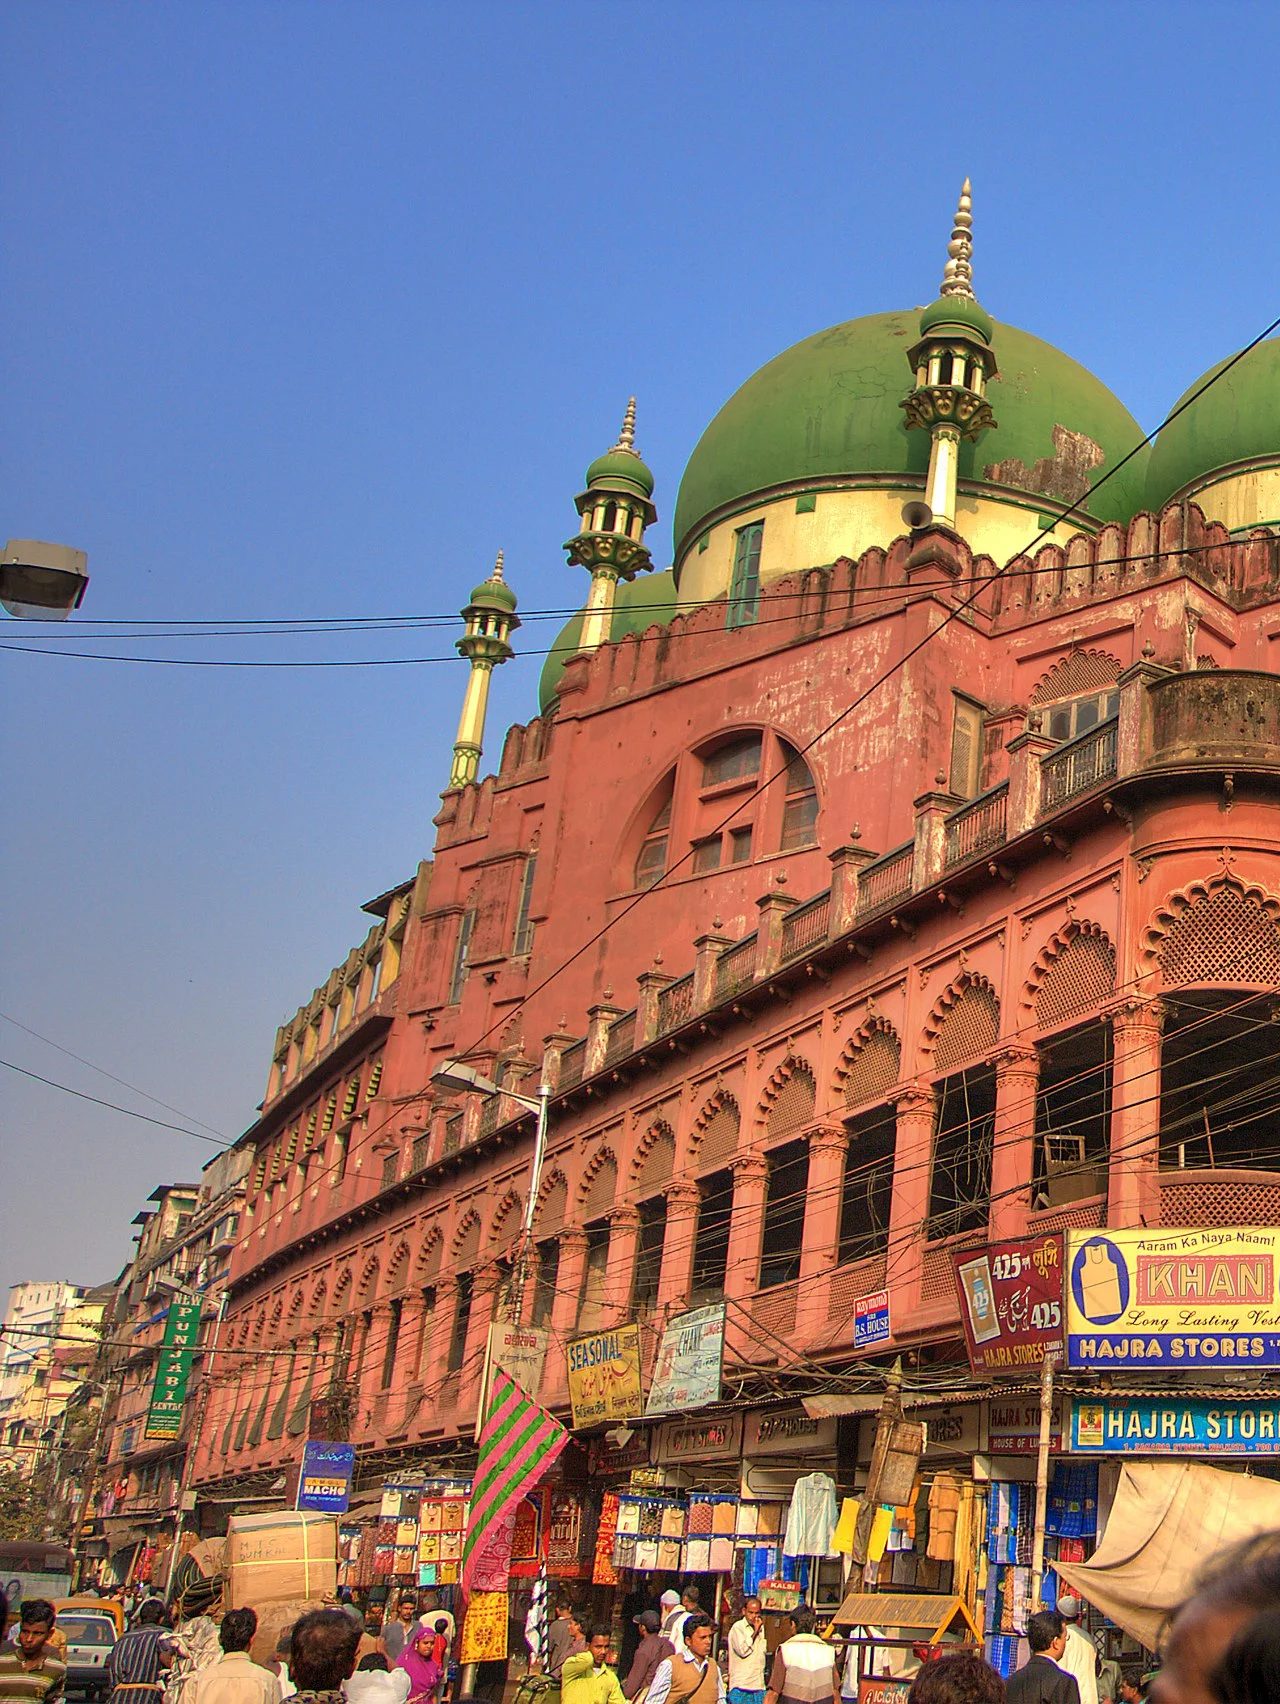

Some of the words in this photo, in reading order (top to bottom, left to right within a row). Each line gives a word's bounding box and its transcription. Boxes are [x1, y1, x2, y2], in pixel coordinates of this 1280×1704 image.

[1137, 1240, 1177, 1251] Aaram
[1181, 1236, 1198, 1247] Ka
[1202, 1233, 1232, 1245] Naya
[1236, 1231, 1275, 1247] Naam!
[992, 1252, 1021, 1280] 425
[1147, 1262, 1265, 1298] KHAN
[172, 1291, 201, 1306] NEW
[867, 1317, 888, 1334] HOUSE
[1030, 1301, 1060, 1329] 425
[1126, 1310, 1170, 1331] Long
[1177, 1310, 1240, 1331] Lasting
[569, 1333, 622, 1372] SEASONAL
[984, 1346, 1013, 1368] HAJRA
[1013, 1342, 1045, 1364] STORES
[1079, 1338, 1160, 1359] HAJRA
[1170, 1337, 1265, 1359] STORES
[991, 1409, 1021, 1427] HAJRA
[1024, 1406, 1060, 1426] STOES
[1108, 1410, 1196, 1439] HAJRA
[993, 1438, 1013, 1449] HOUSE
[1017, 1437, 1025, 1448] OF
[1134, 1443, 1170, 1452] ZAKARIA
[1209, 1443, 1246, 1452] KOLKATA
[304, 1486, 346, 1496] MACHO
